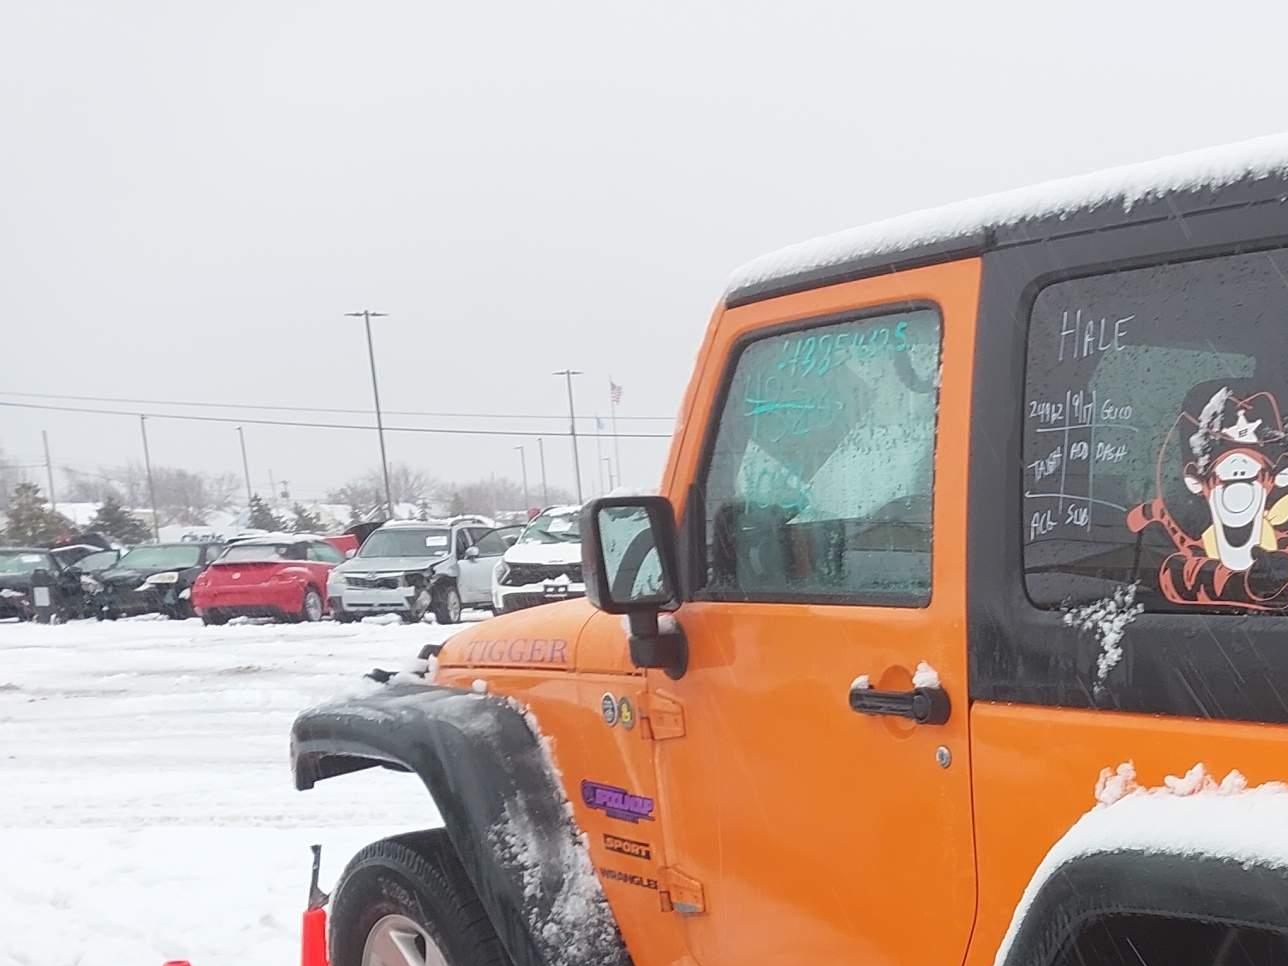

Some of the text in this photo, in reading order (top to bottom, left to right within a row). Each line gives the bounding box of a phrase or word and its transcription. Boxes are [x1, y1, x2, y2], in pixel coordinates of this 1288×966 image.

[1058, 309, 1136, 362] HALE
[466, 637, 568, 664] TIGGER
[605, 836, 648, 858] SPORT
